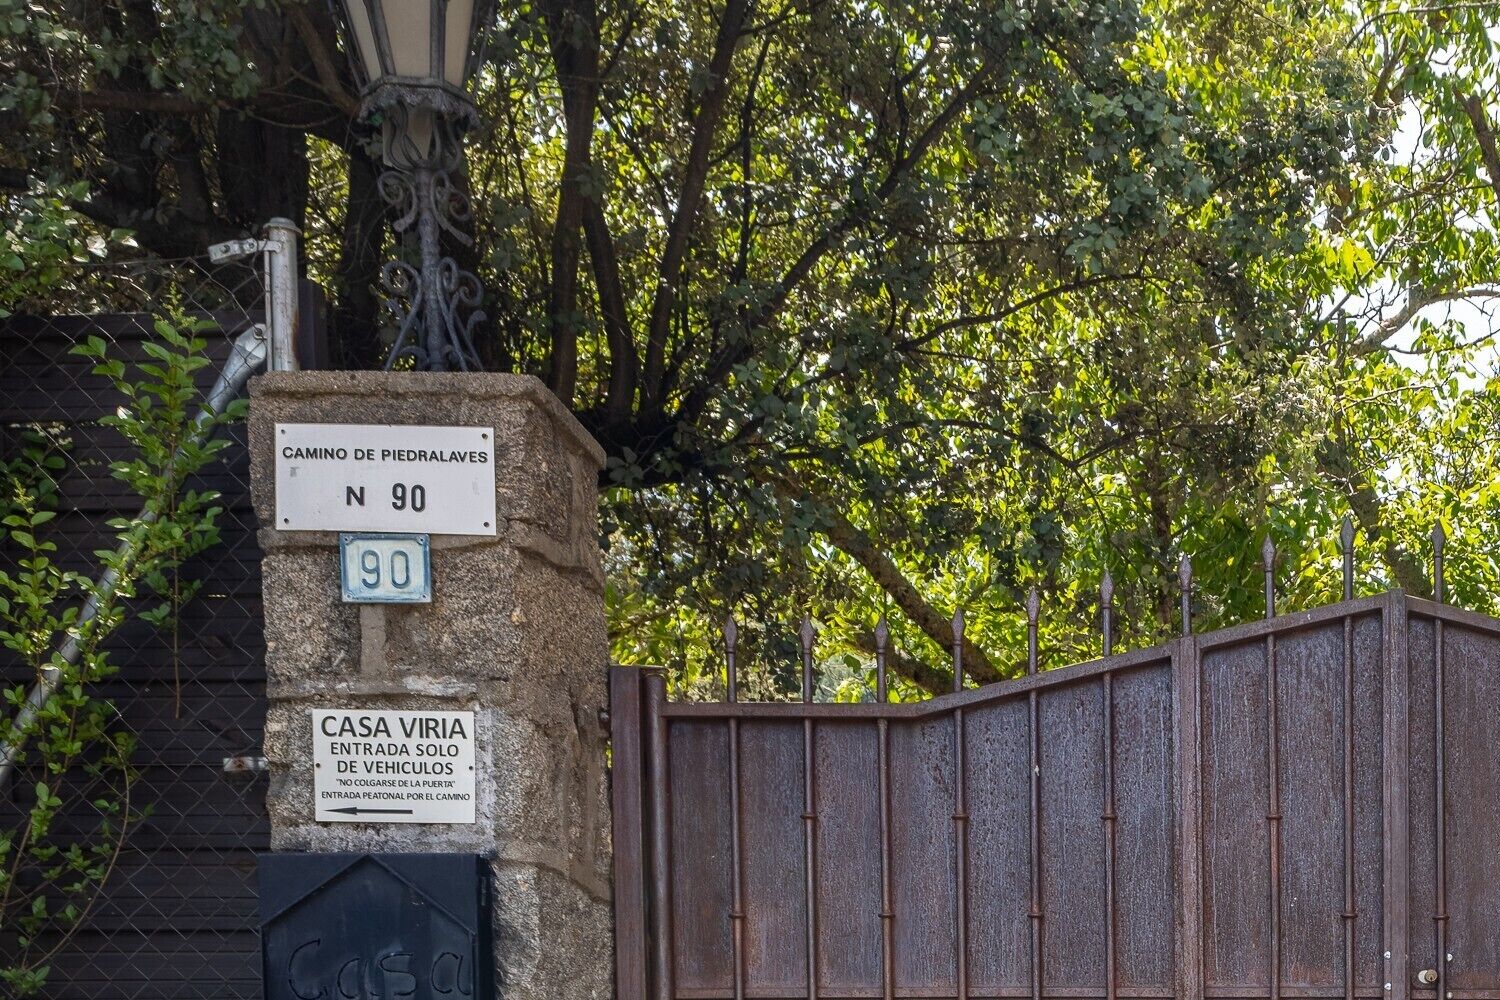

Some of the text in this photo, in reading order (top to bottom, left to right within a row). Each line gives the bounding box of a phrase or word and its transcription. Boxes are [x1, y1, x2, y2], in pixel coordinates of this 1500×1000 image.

[282, 447, 488, 464] CAMINO DE PIEDRALAVES
[346, 483, 426, 512] N 90
[361, 550, 410, 589] 90
[321, 715, 467, 739] CASA VIRIA
[331, 742, 459, 757] ENTRADA SOLO
[338, 760, 453, 775] DE VEHICULOS
[355, 779, 396, 787] COLGARSE
[399, 779, 409, 787] DE
[322, 791, 361, 799] ENTRADA
[363, 792, 405, 800] PEATONAL
[288, 938, 471, 1000] Casa
